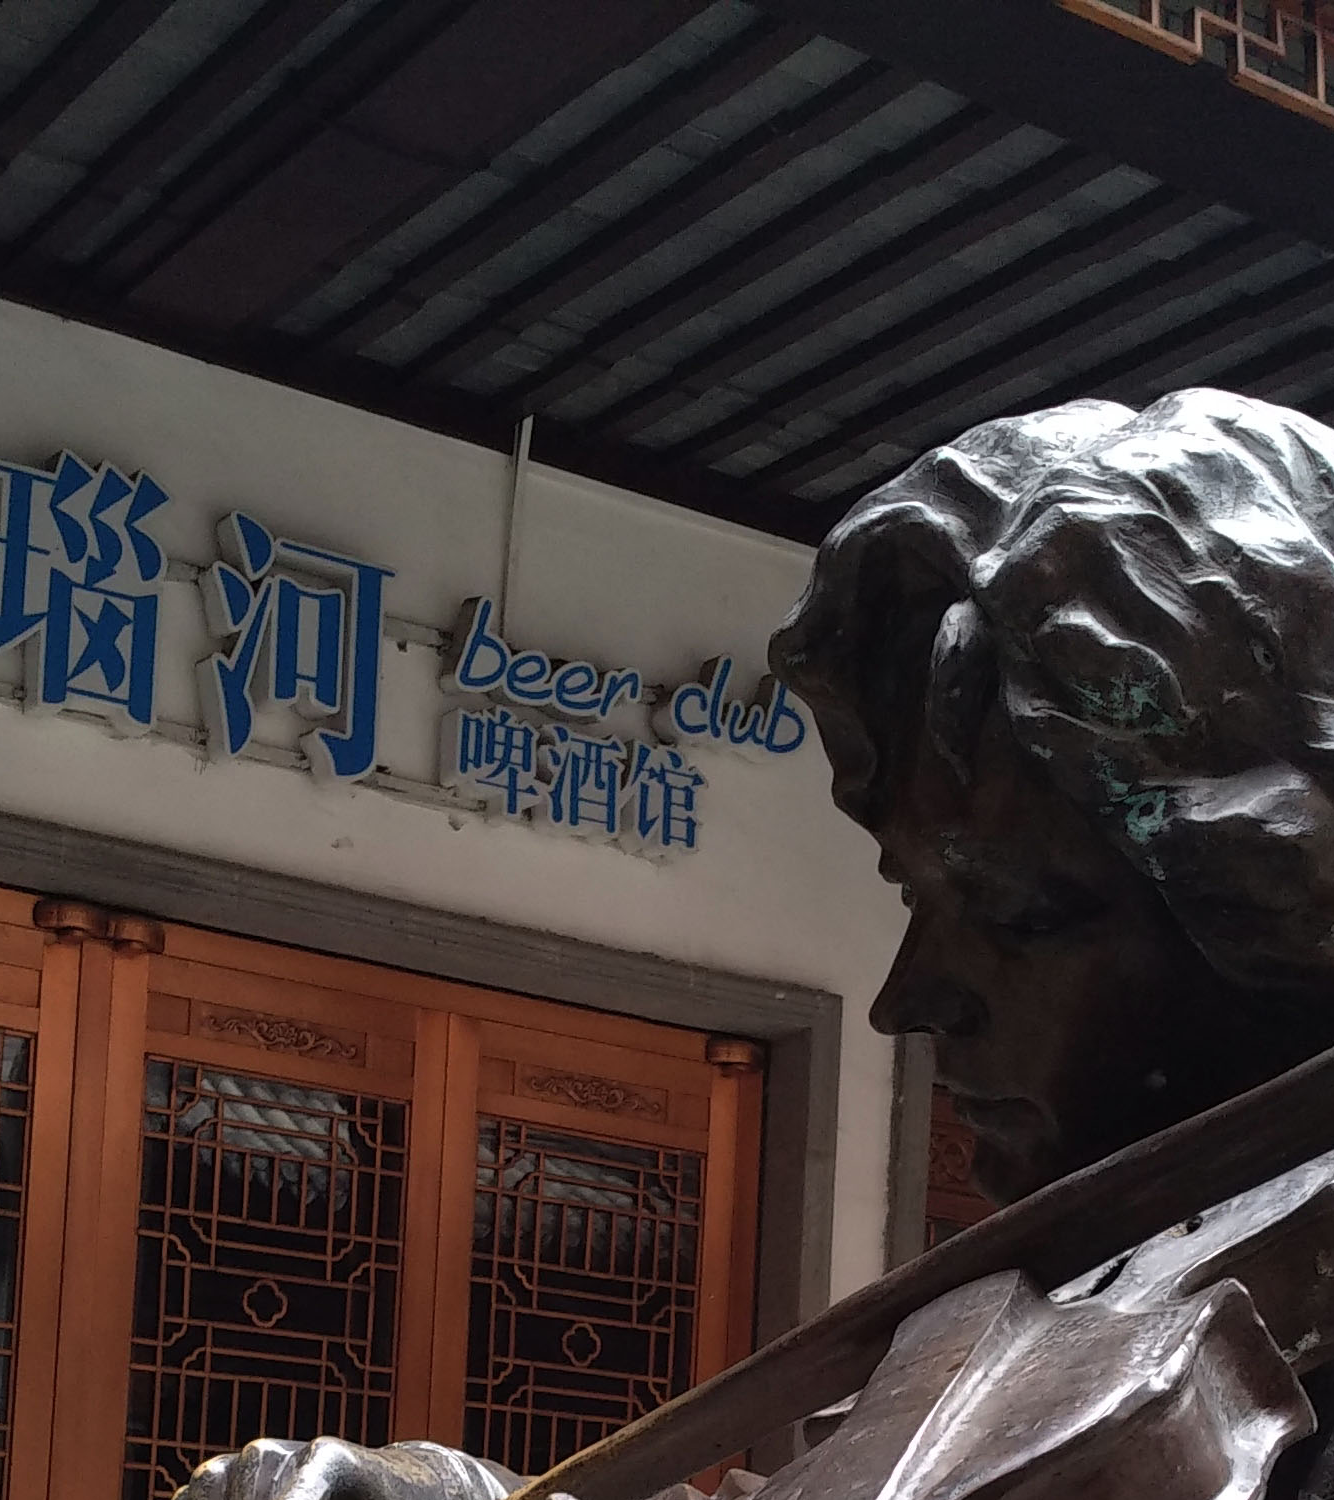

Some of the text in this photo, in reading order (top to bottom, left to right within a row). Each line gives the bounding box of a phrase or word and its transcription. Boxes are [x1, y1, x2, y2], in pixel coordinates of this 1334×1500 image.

[458, 599, 806, 754] beer club
[458, 711, 704, 849] 啤酒馆
